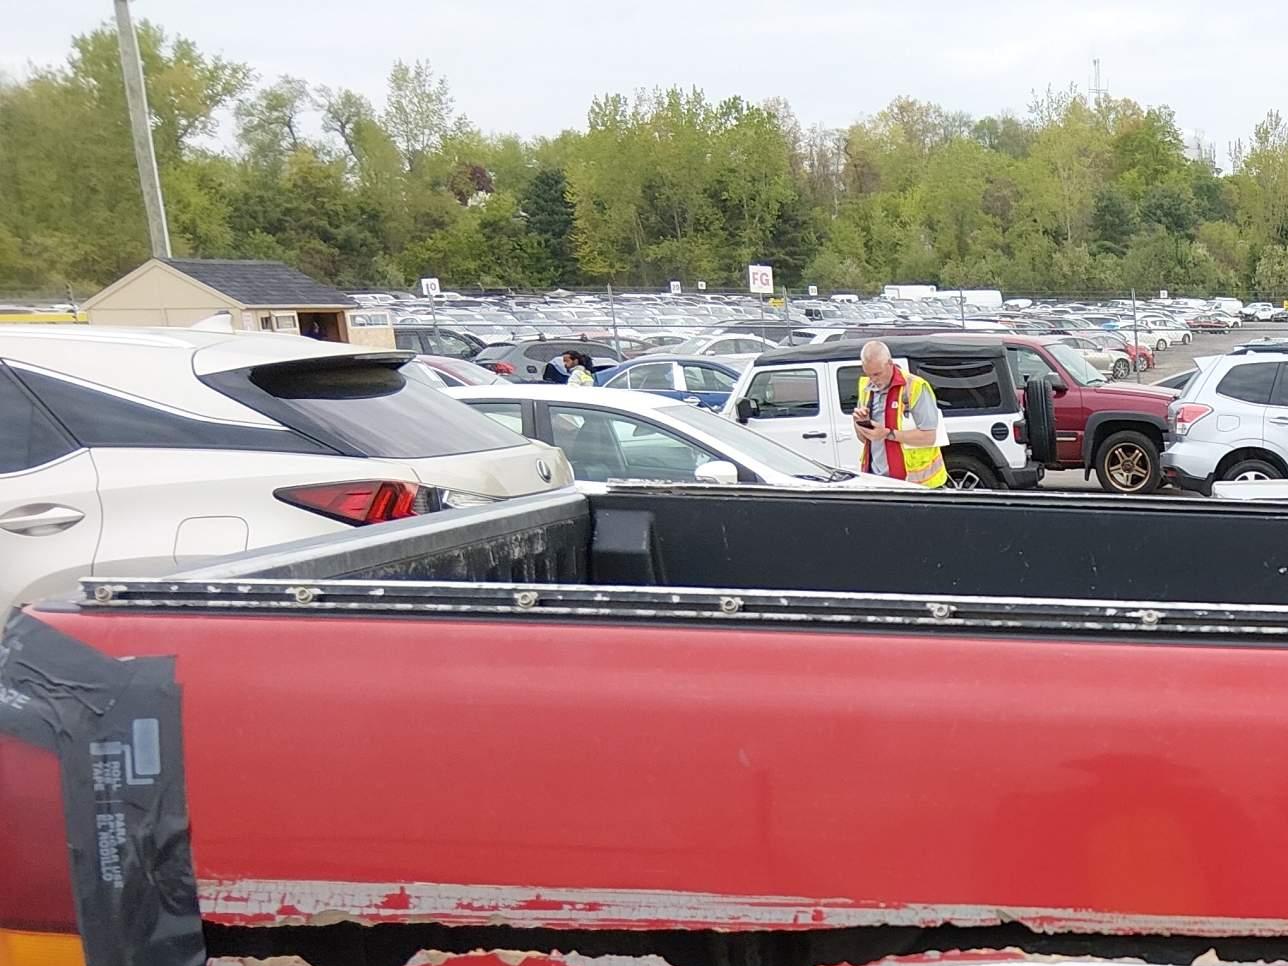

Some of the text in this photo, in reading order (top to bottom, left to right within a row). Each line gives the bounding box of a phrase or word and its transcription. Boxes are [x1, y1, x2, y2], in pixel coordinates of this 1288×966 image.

[752, 272, 770, 287] FG
[92, 761, 105, 792] TAPE
[110, 760, 123, 792] ROLL
[114, 812, 127, 845] PARA
[98, 831, 114, 882] RODILLO
